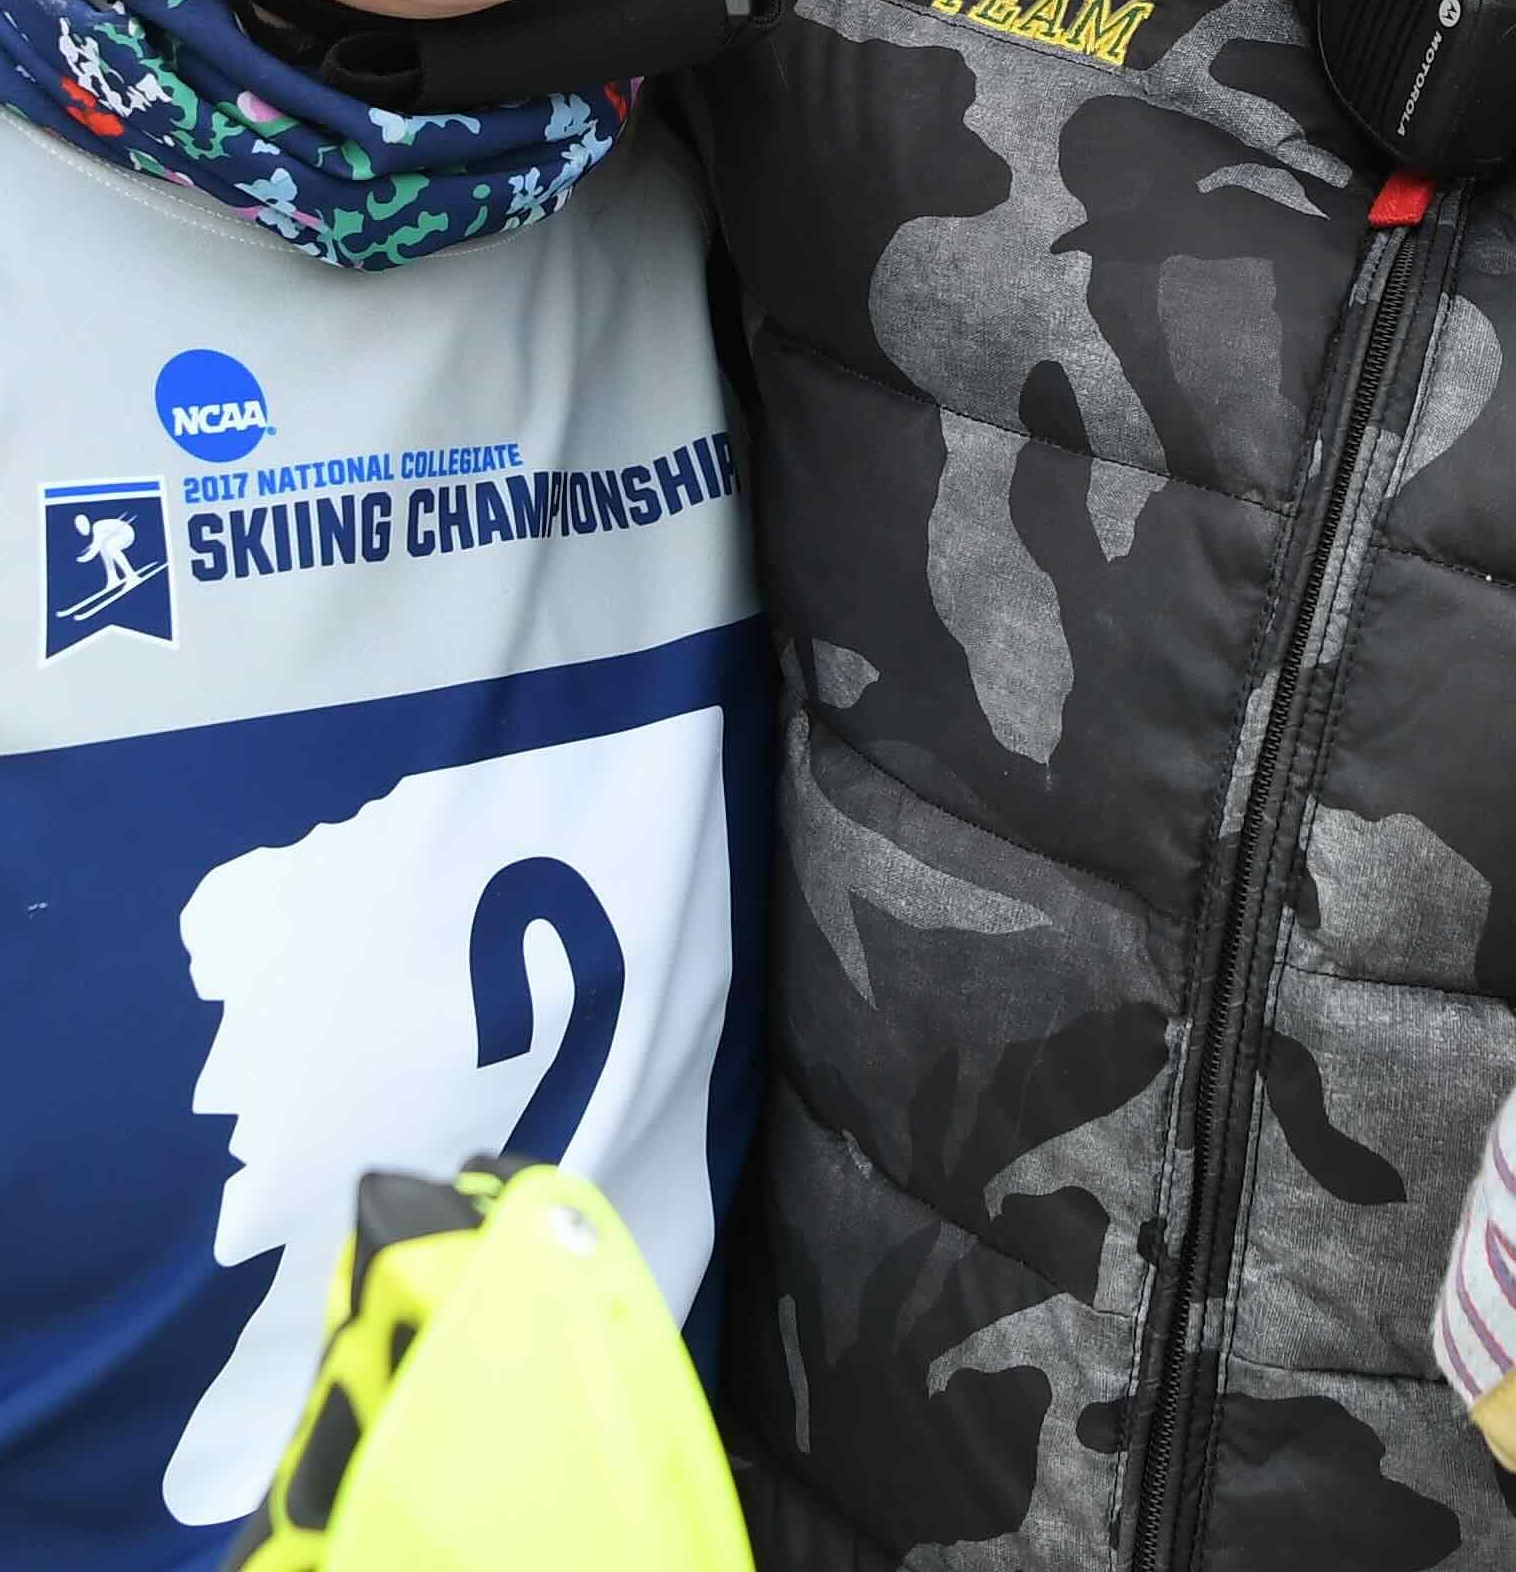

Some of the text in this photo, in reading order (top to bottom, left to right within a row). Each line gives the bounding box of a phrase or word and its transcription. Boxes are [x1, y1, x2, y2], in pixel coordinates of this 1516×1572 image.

[1397, 30, 1443, 137] MOTOROLA
[172, 399, 267, 437] NCAA
[184, 442, 525, 504] 2017 NATIONAL COLLEGIATE
[187, 491, 393, 582] SKIING
